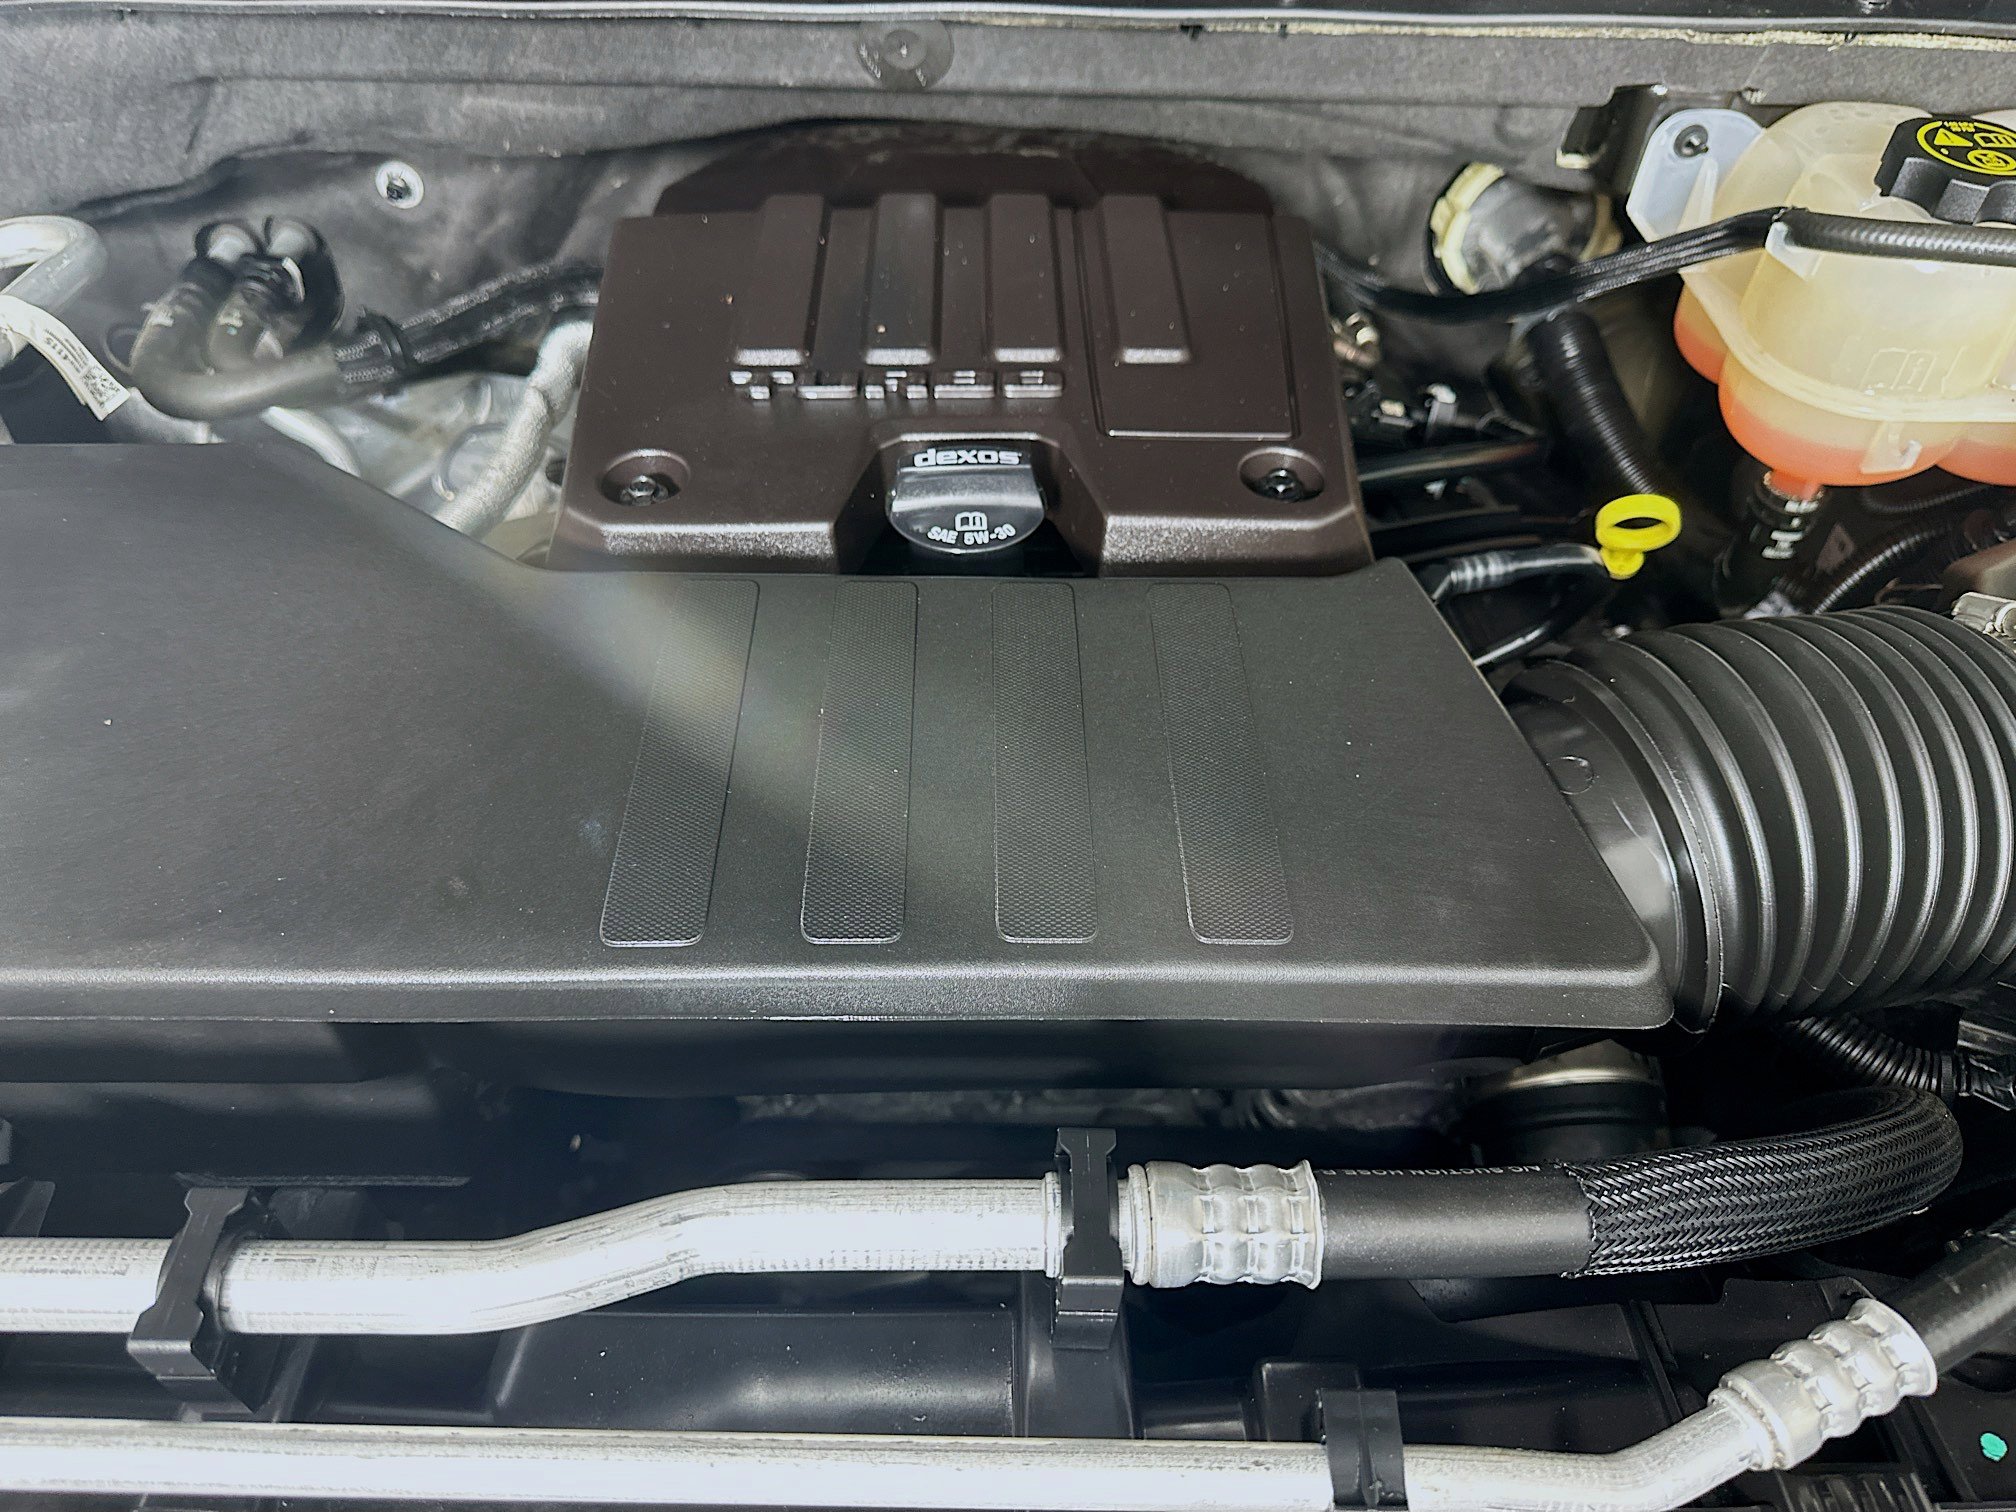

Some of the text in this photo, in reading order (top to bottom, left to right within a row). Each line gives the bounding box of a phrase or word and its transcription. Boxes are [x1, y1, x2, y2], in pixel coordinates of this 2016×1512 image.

[730, 369, 1064, 401] TURBO
[913, 448, 1022, 467] dexos
[926, 523, 1016, 546] SAE 5W-30
[1344, 1168, 1404, 1177] HOSE
[1409, 1166, 1504, 1176] SUCTION
